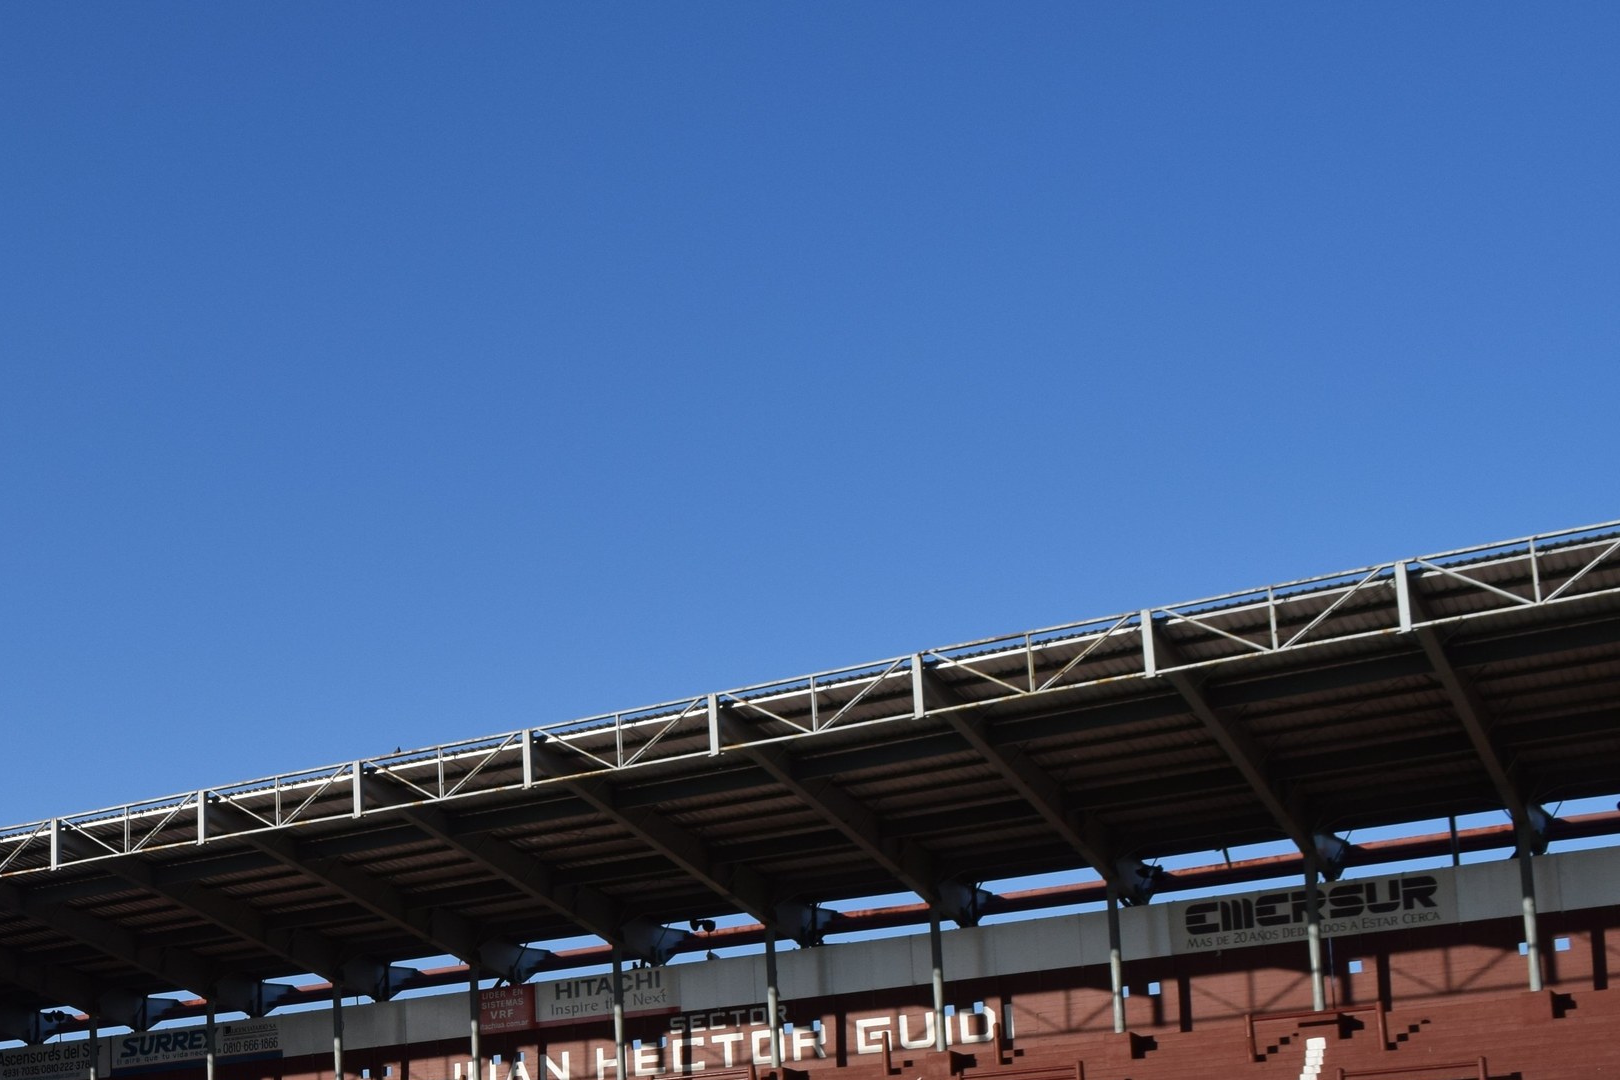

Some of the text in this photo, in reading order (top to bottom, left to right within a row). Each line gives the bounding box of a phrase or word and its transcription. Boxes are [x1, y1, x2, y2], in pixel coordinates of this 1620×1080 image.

[1185, 875, 1438, 935] EMERSUR
[1234, 932, 1248, 944] 20
[1282, 922, 1347, 938] DEDIADOS
[512, 988, 523, 997] EN
[554, 971, 660, 1000] HITACHI
[482, 997, 524, 1010] SISTEMAS
[551, 1002, 598, 1017] Inspire
[633, 988, 667, 1006] Next
[490, 1009, 515, 1019] VRF
[669, 1004, 788, 1034] SECTOR
[64, 1043, 80, 1059] del
[82, 1042, 102, 1058] Sr
